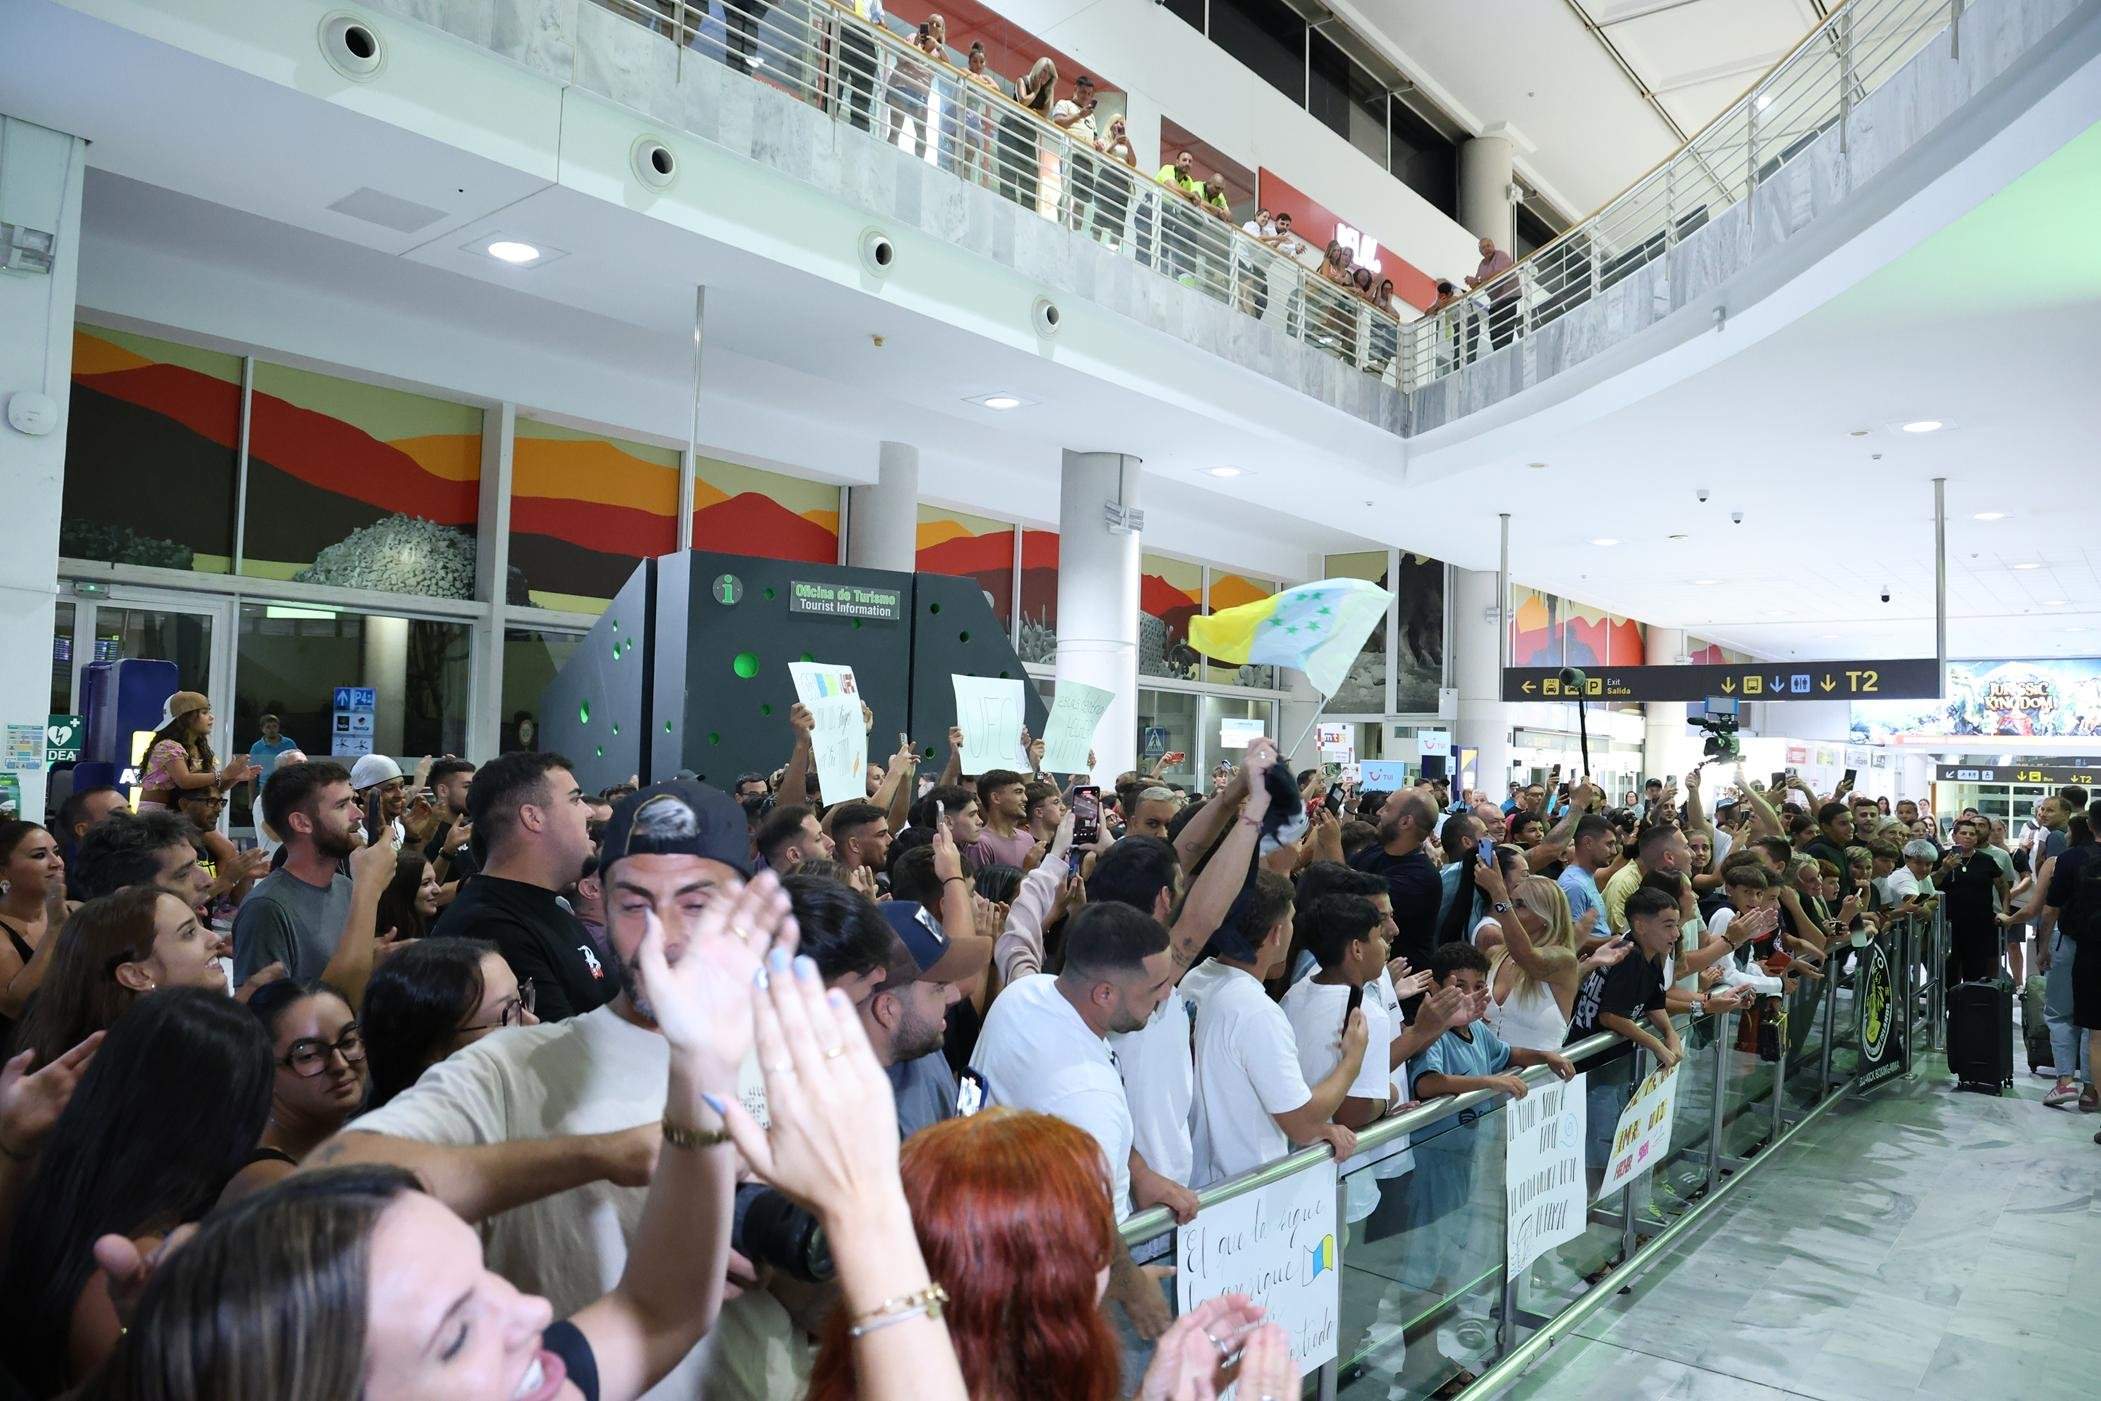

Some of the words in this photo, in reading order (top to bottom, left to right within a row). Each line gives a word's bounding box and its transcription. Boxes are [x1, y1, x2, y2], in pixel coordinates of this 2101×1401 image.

[795, 584, 834, 600] Oficina
[837, 588, 851, 601] de
[853, 589, 896, 606] Turismo
[800, 598, 834, 612] Tourist
[837, 601, 891, 617] Information
[1607, 678, 1621, 686] Exit
[1846, 670, 1879, 692] T2
[1607, 687, 1631, 695] Salida
[48, 750, 75, 761] DEA
[2079, 775, 2092, 784] T2
[1185, 1226, 1206, 1279] El
[1279, 1199, 1321, 1250] sigue
